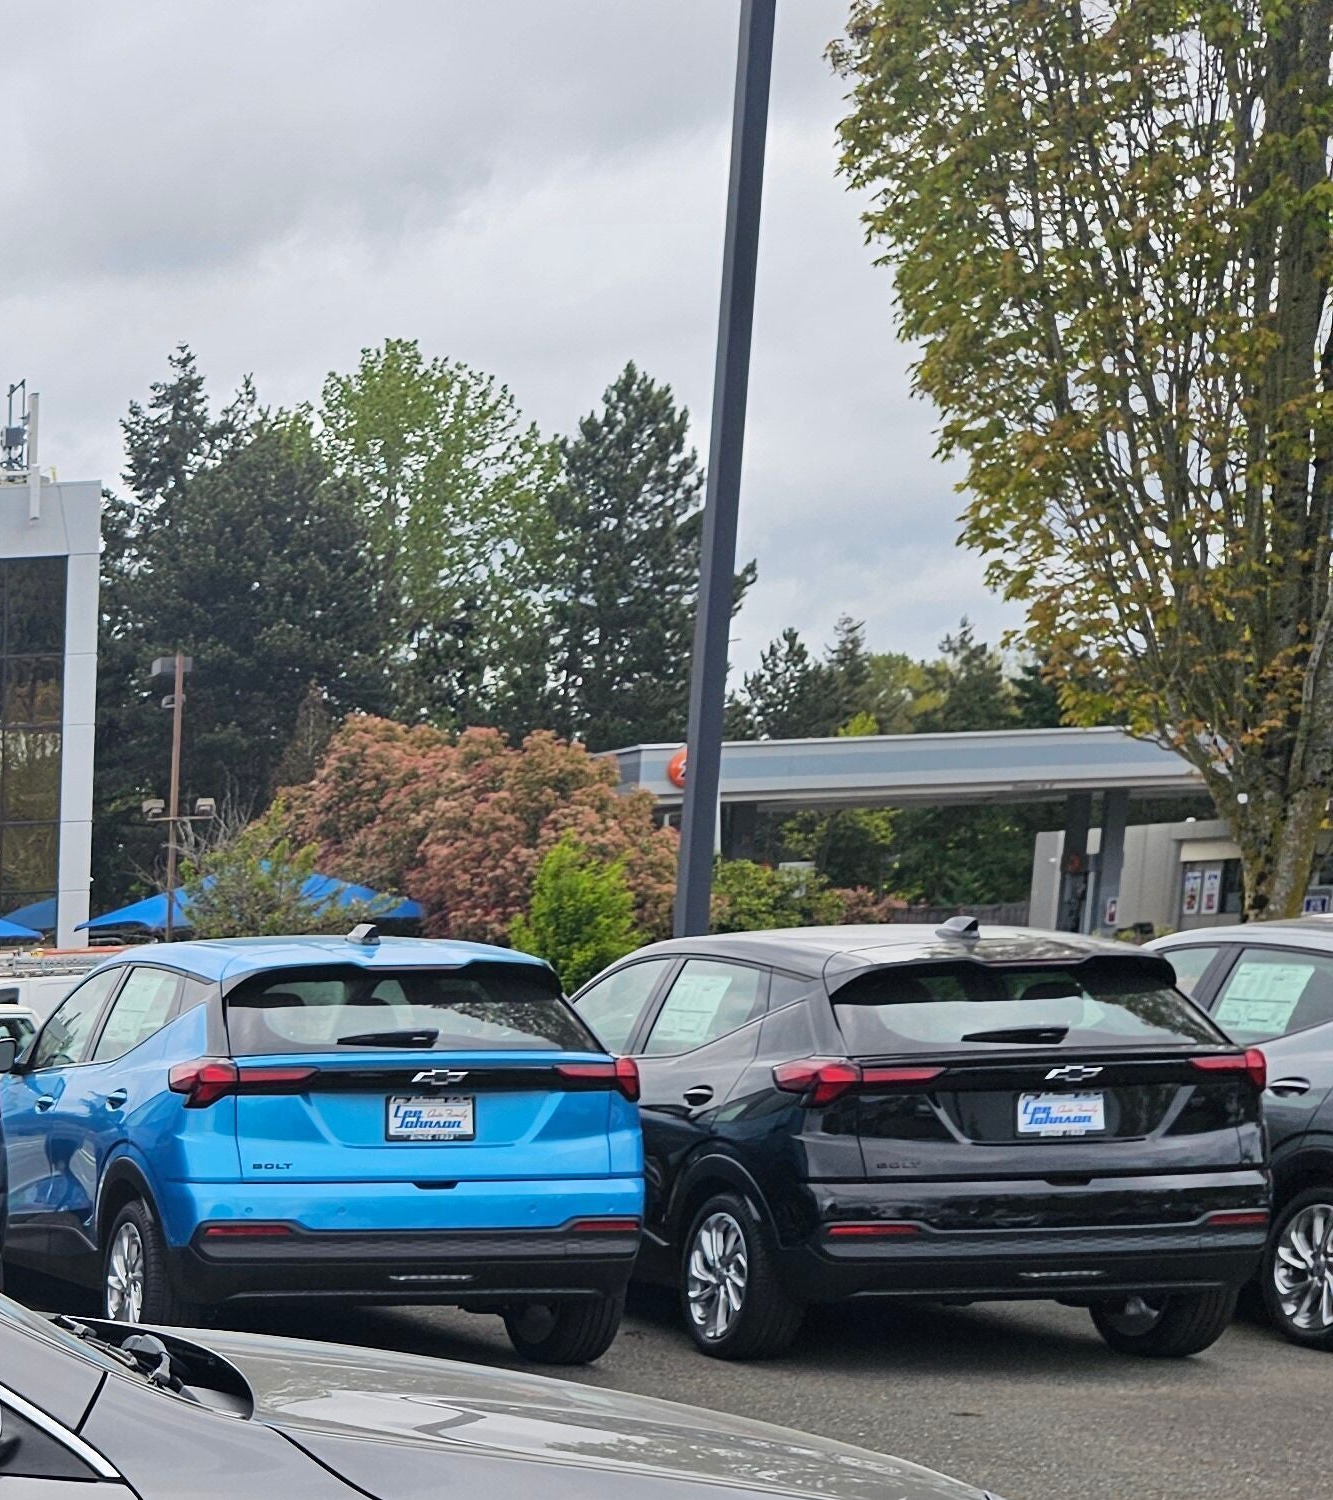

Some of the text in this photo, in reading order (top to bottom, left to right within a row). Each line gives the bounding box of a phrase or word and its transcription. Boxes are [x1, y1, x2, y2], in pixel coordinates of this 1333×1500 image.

[394, 1105, 423, 1118] Lee
[1023, 1101, 1052, 1115] Lee
[395, 1115, 463, 1129] Johnson
[1024, 1111, 1093, 1125] Johnson
